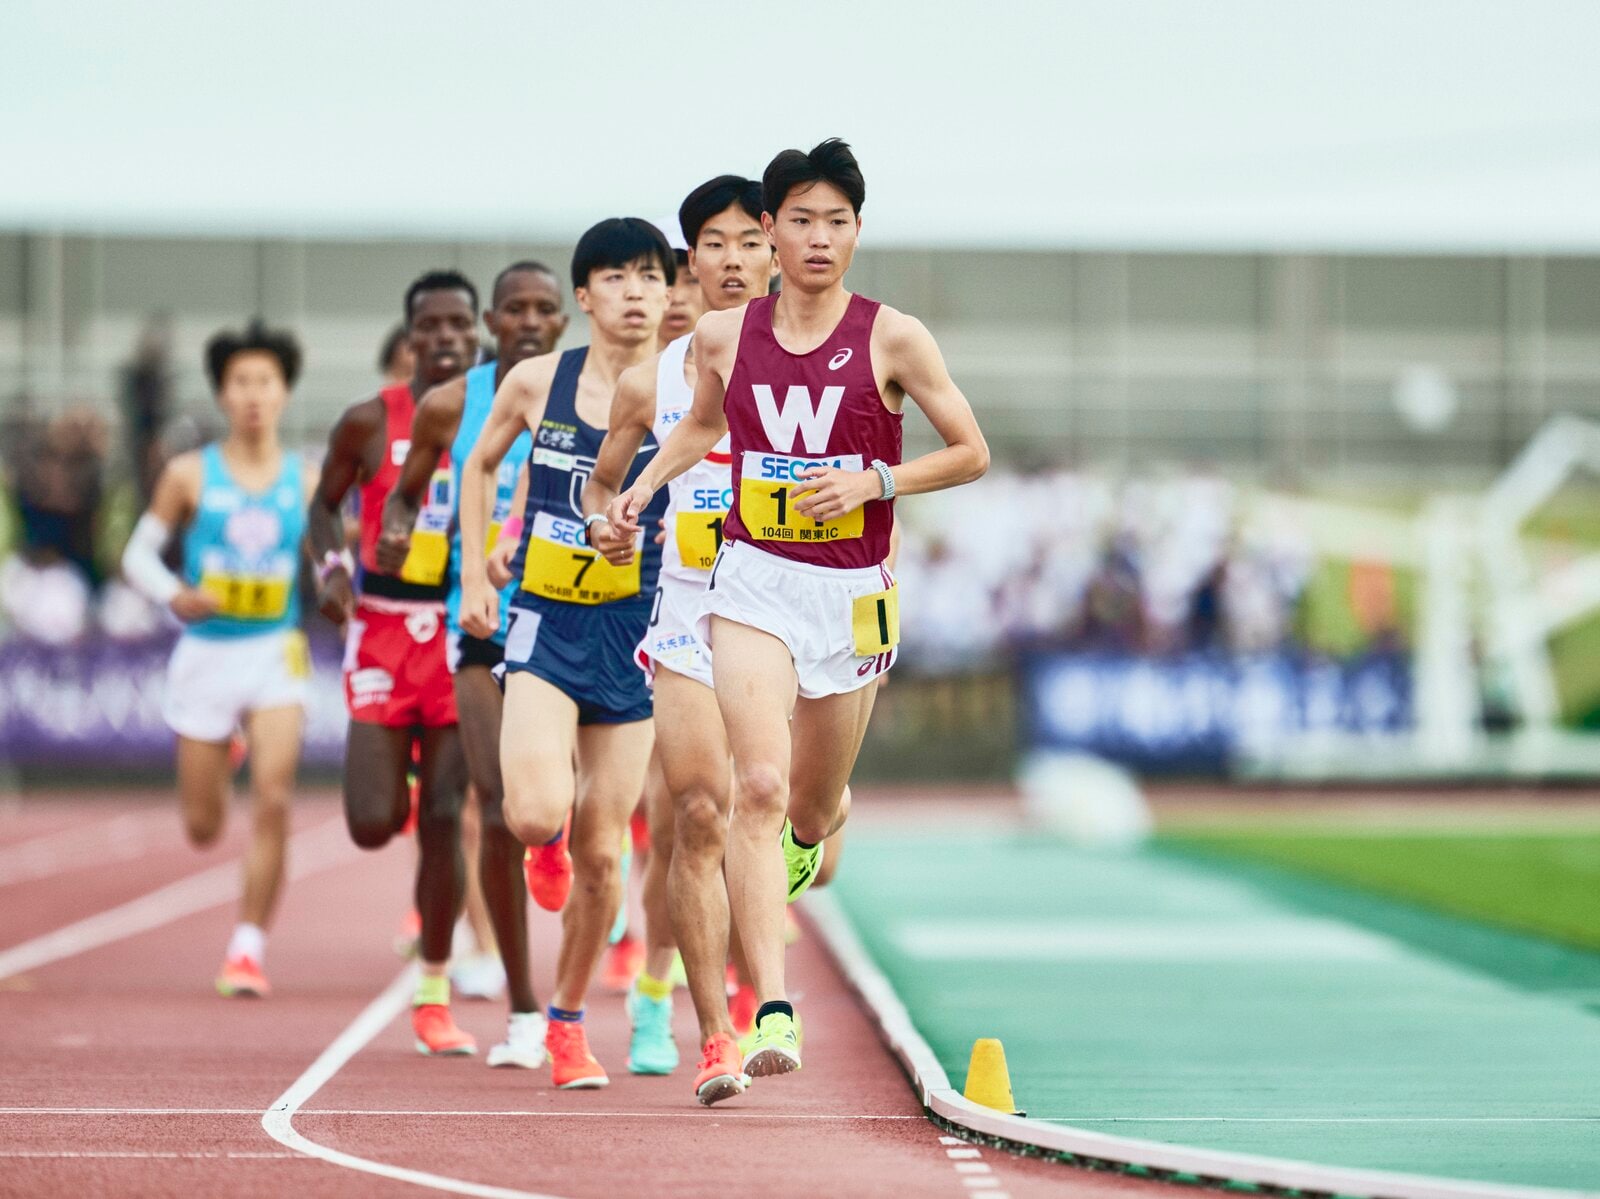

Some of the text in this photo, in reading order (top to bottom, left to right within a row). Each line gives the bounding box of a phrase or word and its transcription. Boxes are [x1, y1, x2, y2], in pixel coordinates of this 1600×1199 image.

[751, 384, 846, 454] W
[761, 526, 838, 540] 104回 関東IC
[572, 553, 595, 588] 7
